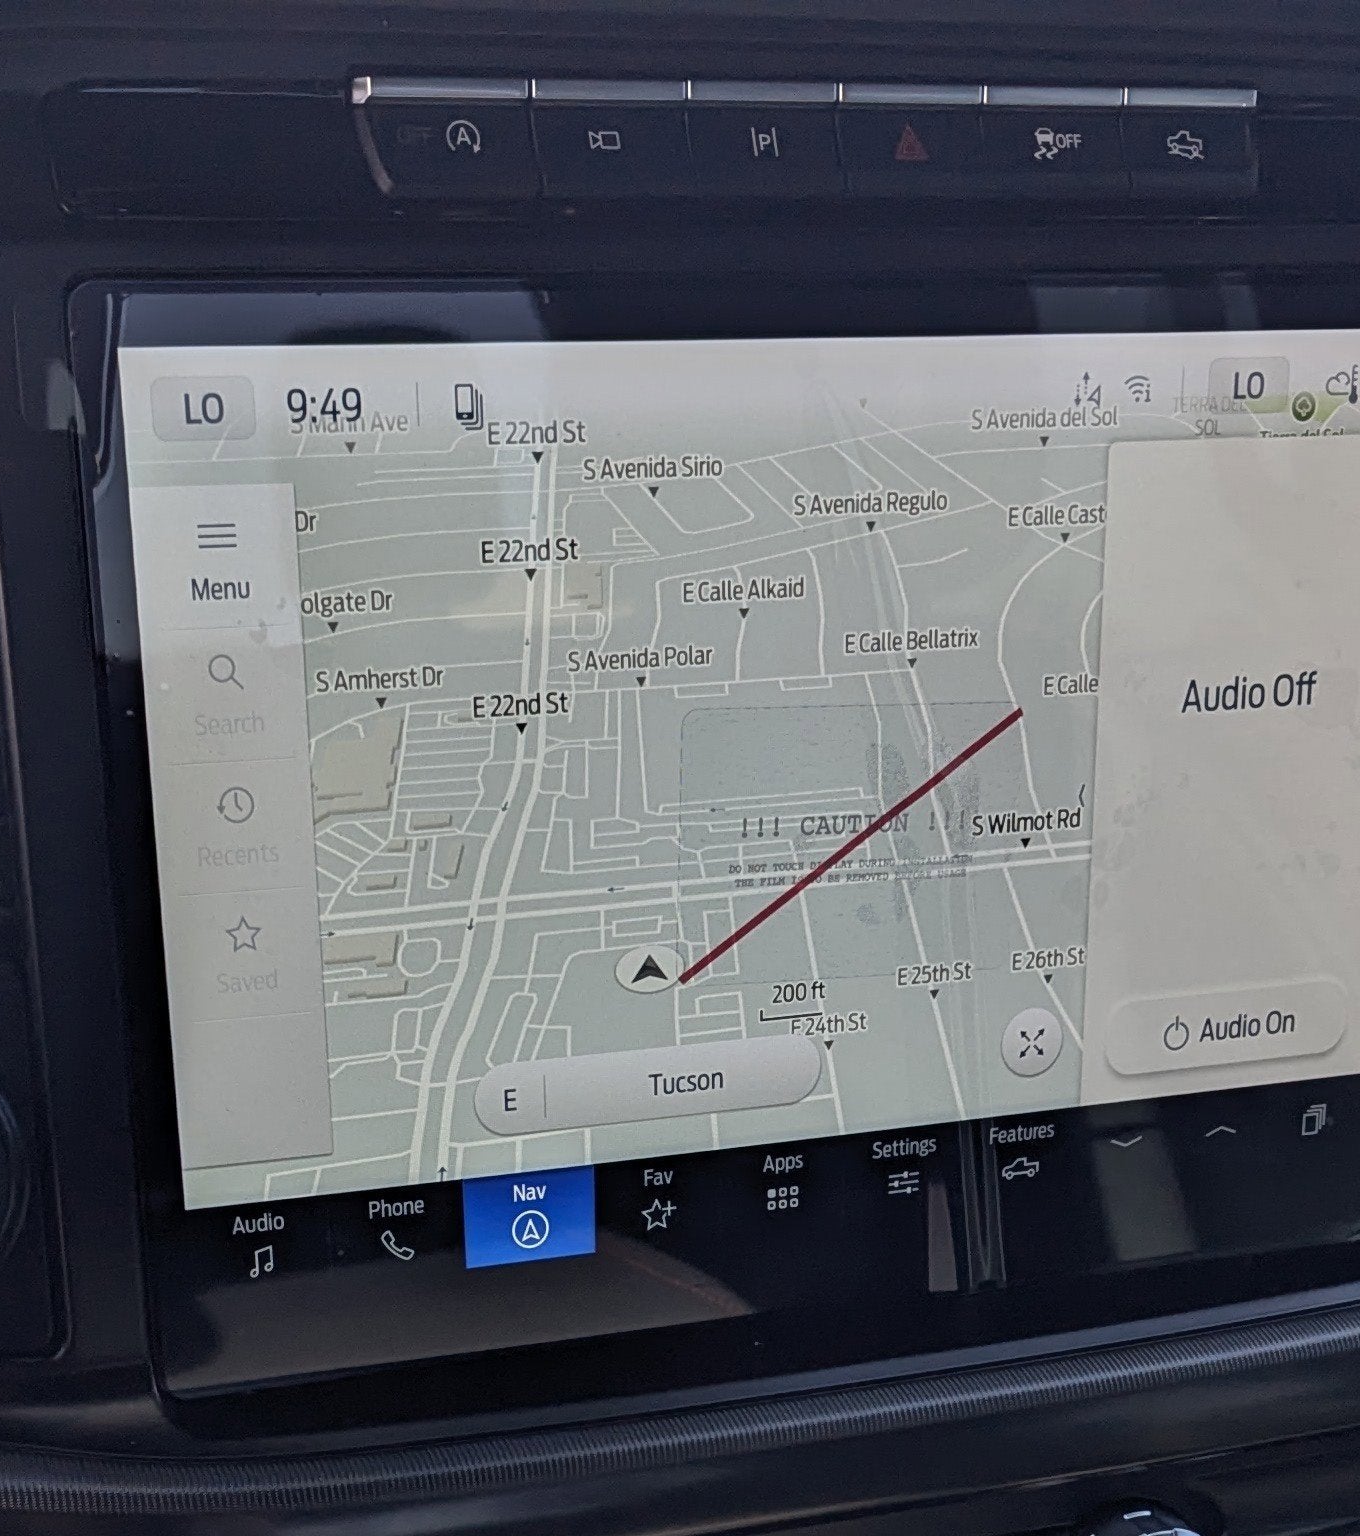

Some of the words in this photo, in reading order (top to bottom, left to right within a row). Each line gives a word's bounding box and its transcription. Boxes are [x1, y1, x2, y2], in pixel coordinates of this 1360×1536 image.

[1055, 132, 1082, 150] OFF
[1233, 371, 1265, 400] LO
[184, 392, 225, 425] LO
[287, 387, 362, 424] 9:49
[972, 409, 983, 429] S
[987, 408, 1057, 429] Avenida
[1061, 407, 1087, 428] del
[1091, 406, 1118, 426] Sol
[371, 411, 408, 432] Ave
[488, 423, 500, 446] E
[506, 421, 558, 445] 22nd
[563, 419, 586, 443] St
[1195, 419, 1221, 436] SOL
[584, 460, 596, 481] S
[600, 457, 677, 480] Avenida
[682, 456, 723, 478] Sirio
[795, 494, 807, 515] S
[810, 492, 882, 515] Avenida
[887, 490, 947, 515] Regulo
[295, 510, 317, 532] Dr
[1008, 507, 1019, 526] E
[1023, 505, 1065, 526] Calle
[1068, 504, 1107, 524] Cast
[481, 541, 494, 564] E
[499, 539, 551, 563] 22nd
[555, 538, 579, 561] St
[191, 577, 251, 600] Menu
[371, 590, 392, 611] Dr
[683, 583, 695, 602] E
[698, 581, 744, 602] Calle
[748, 577, 805, 600] Alkaid
[845, 634, 855, 654] E
[859, 631, 903, 652] Calle
[907, 628, 980, 650] Bellatrix
[568, 652, 580, 672] S
[584, 649, 660, 670] Avenida
[664, 645, 713, 667] Polar
[316, 671, 329, 692] S
[334, 667, 418, 691] Amherst
[423, 665, 445, 687] Dr
[1044, 677, 1055, 695] E
[1057, 674, 1099, 694] Calle
[1181, 676, 1265, 713] Audio
[1273, 671, 1318, 708] Off
[473, 697, 485, 718] E
[490, 694, 541, 716] 22nd
[546, 692, 569, 714] St
[195, 713, 265, 735] Search
[972, 815, 984, 837] S
[987, 811, 1053, 835] Wilmot
[1058, 807, 1082, 829] Rd
[197, 845, 280, 868] Recents
[1012, 952, 1023, 971] E
[1025, 949, 1064, 970] 26th
[1067, 947, 1086, 966] St
[216, 971, 279, 994] Saved
[897, 967, 907, 986] E
[910, 964, 951, 985] 25th
[954, 962, 972, 981] St
[773, 983, 807, 1004] 200
[811, 981, 825, 999] ft
[805, 1014, 845, 1036] 24th
[848, 1012, 867, 1031] St
[1199, 1014, 1260, 1043] Audio
[1265, 1011, 1295, 1036] On
[648, 1070, 724, 1097] Tucson
[504, 1089, 517, 1112] E
[989, 1121, 1056, 1145] Features
[872, 1136, 938, 1161] Settings
[763, 1152, 804, 1174] Apps
[644, 1168, 674, 1187] Fav
[512, 1183, 547, 1202] Nav
[368, 1198, 425, 1220] Phone
[232, 1213, 285, 1236] Audio
